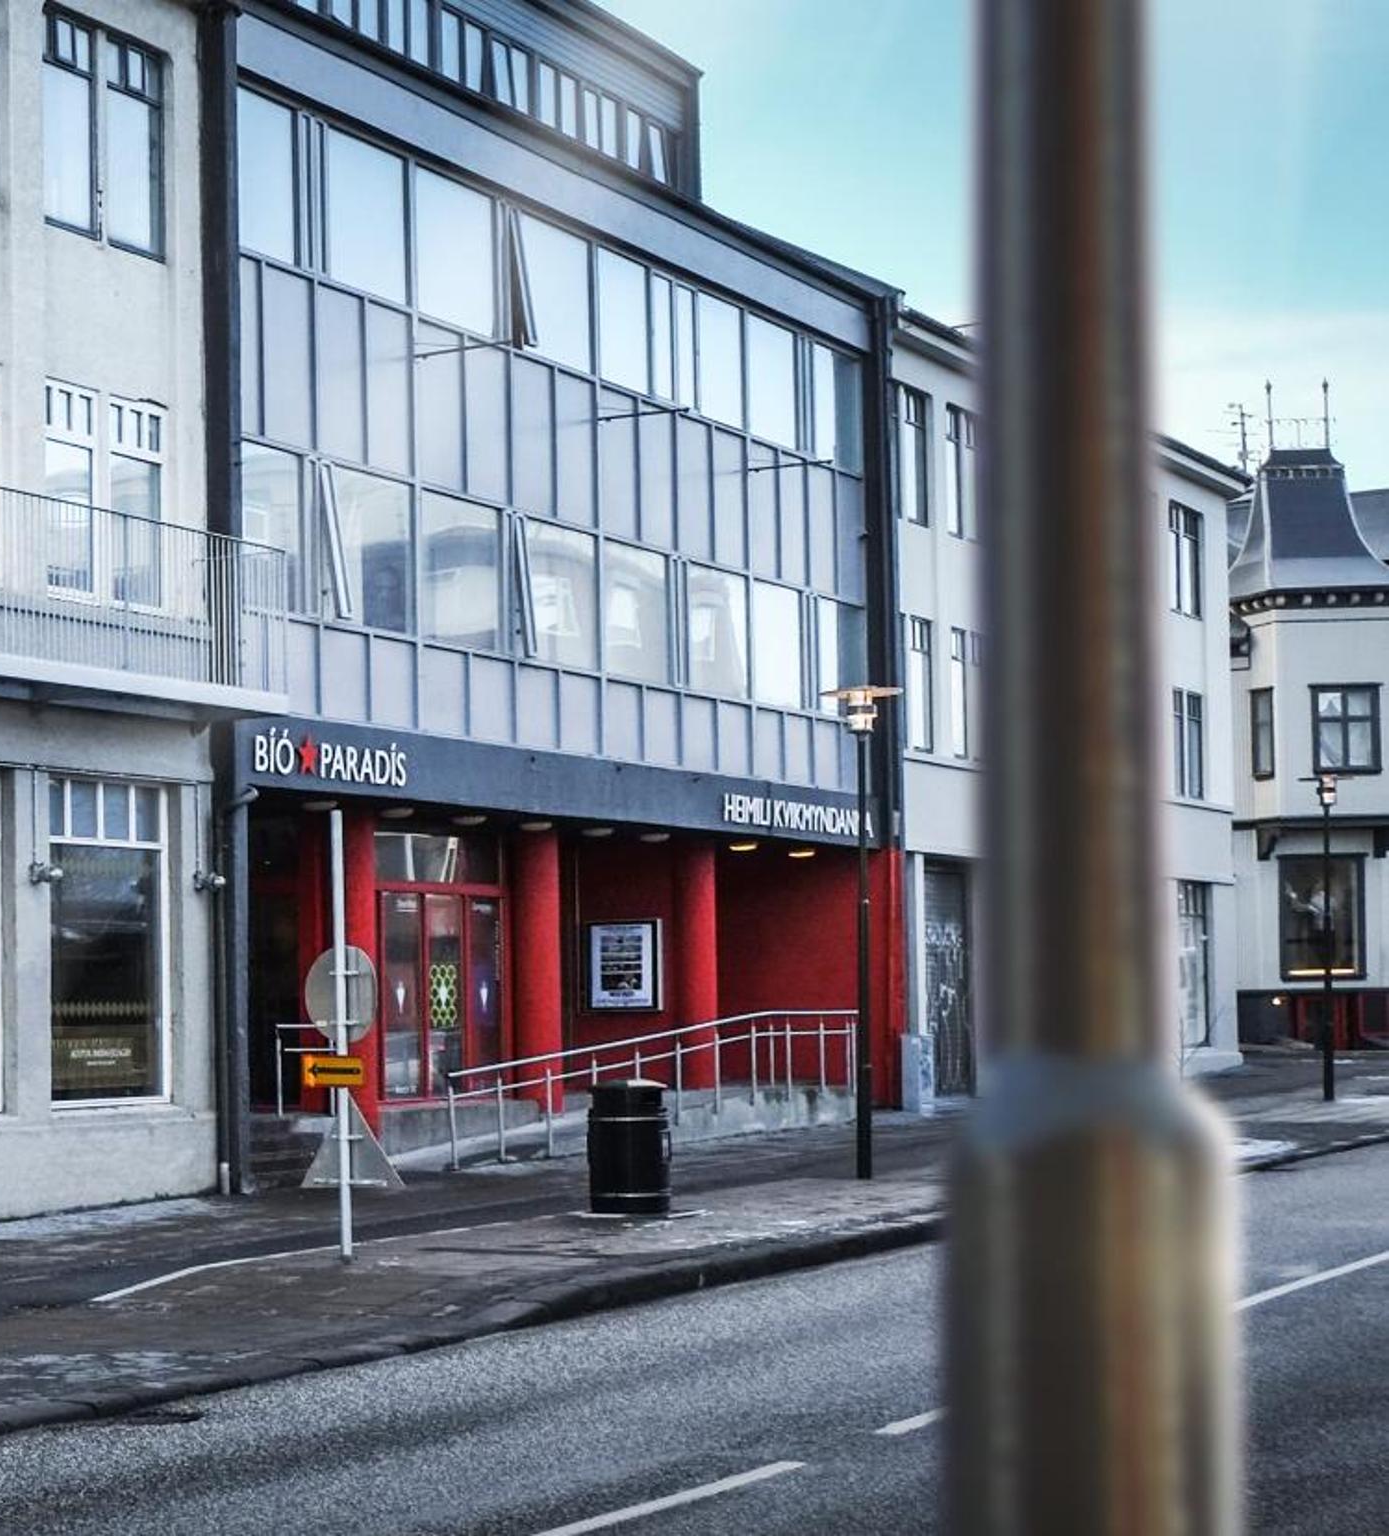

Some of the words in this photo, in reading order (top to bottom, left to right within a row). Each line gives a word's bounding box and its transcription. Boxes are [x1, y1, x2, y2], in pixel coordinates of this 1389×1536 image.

[254, 726, 295, 775] BÍÓ
[319, 742, 407, 787] PARADÍS
[723, 793, 771, 826] HEIMILI
